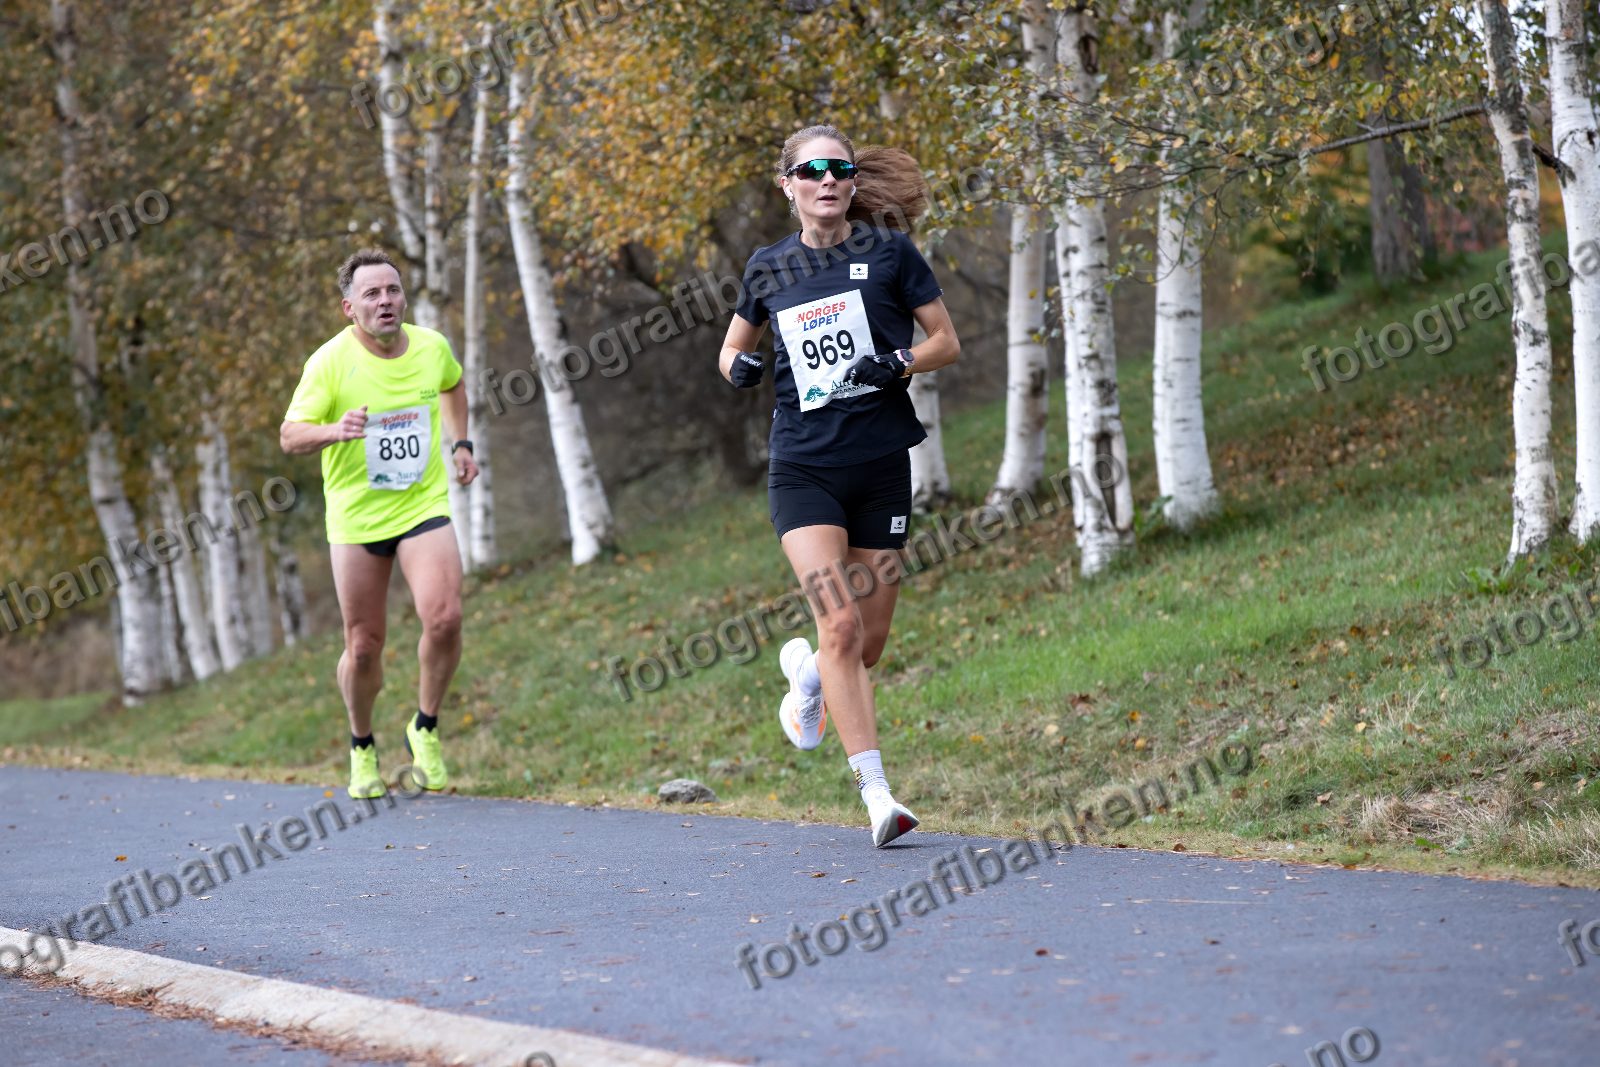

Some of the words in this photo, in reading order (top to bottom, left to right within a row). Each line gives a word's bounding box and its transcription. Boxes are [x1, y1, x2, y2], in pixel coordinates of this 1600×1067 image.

[797, 302, 846, 322] NORGES
[803, 313, 840, 331] LØPET
[802, 330, 855, 370] 969
[381, 412, 419, 424] NORGES
[379, 435, 420, 461] 830
